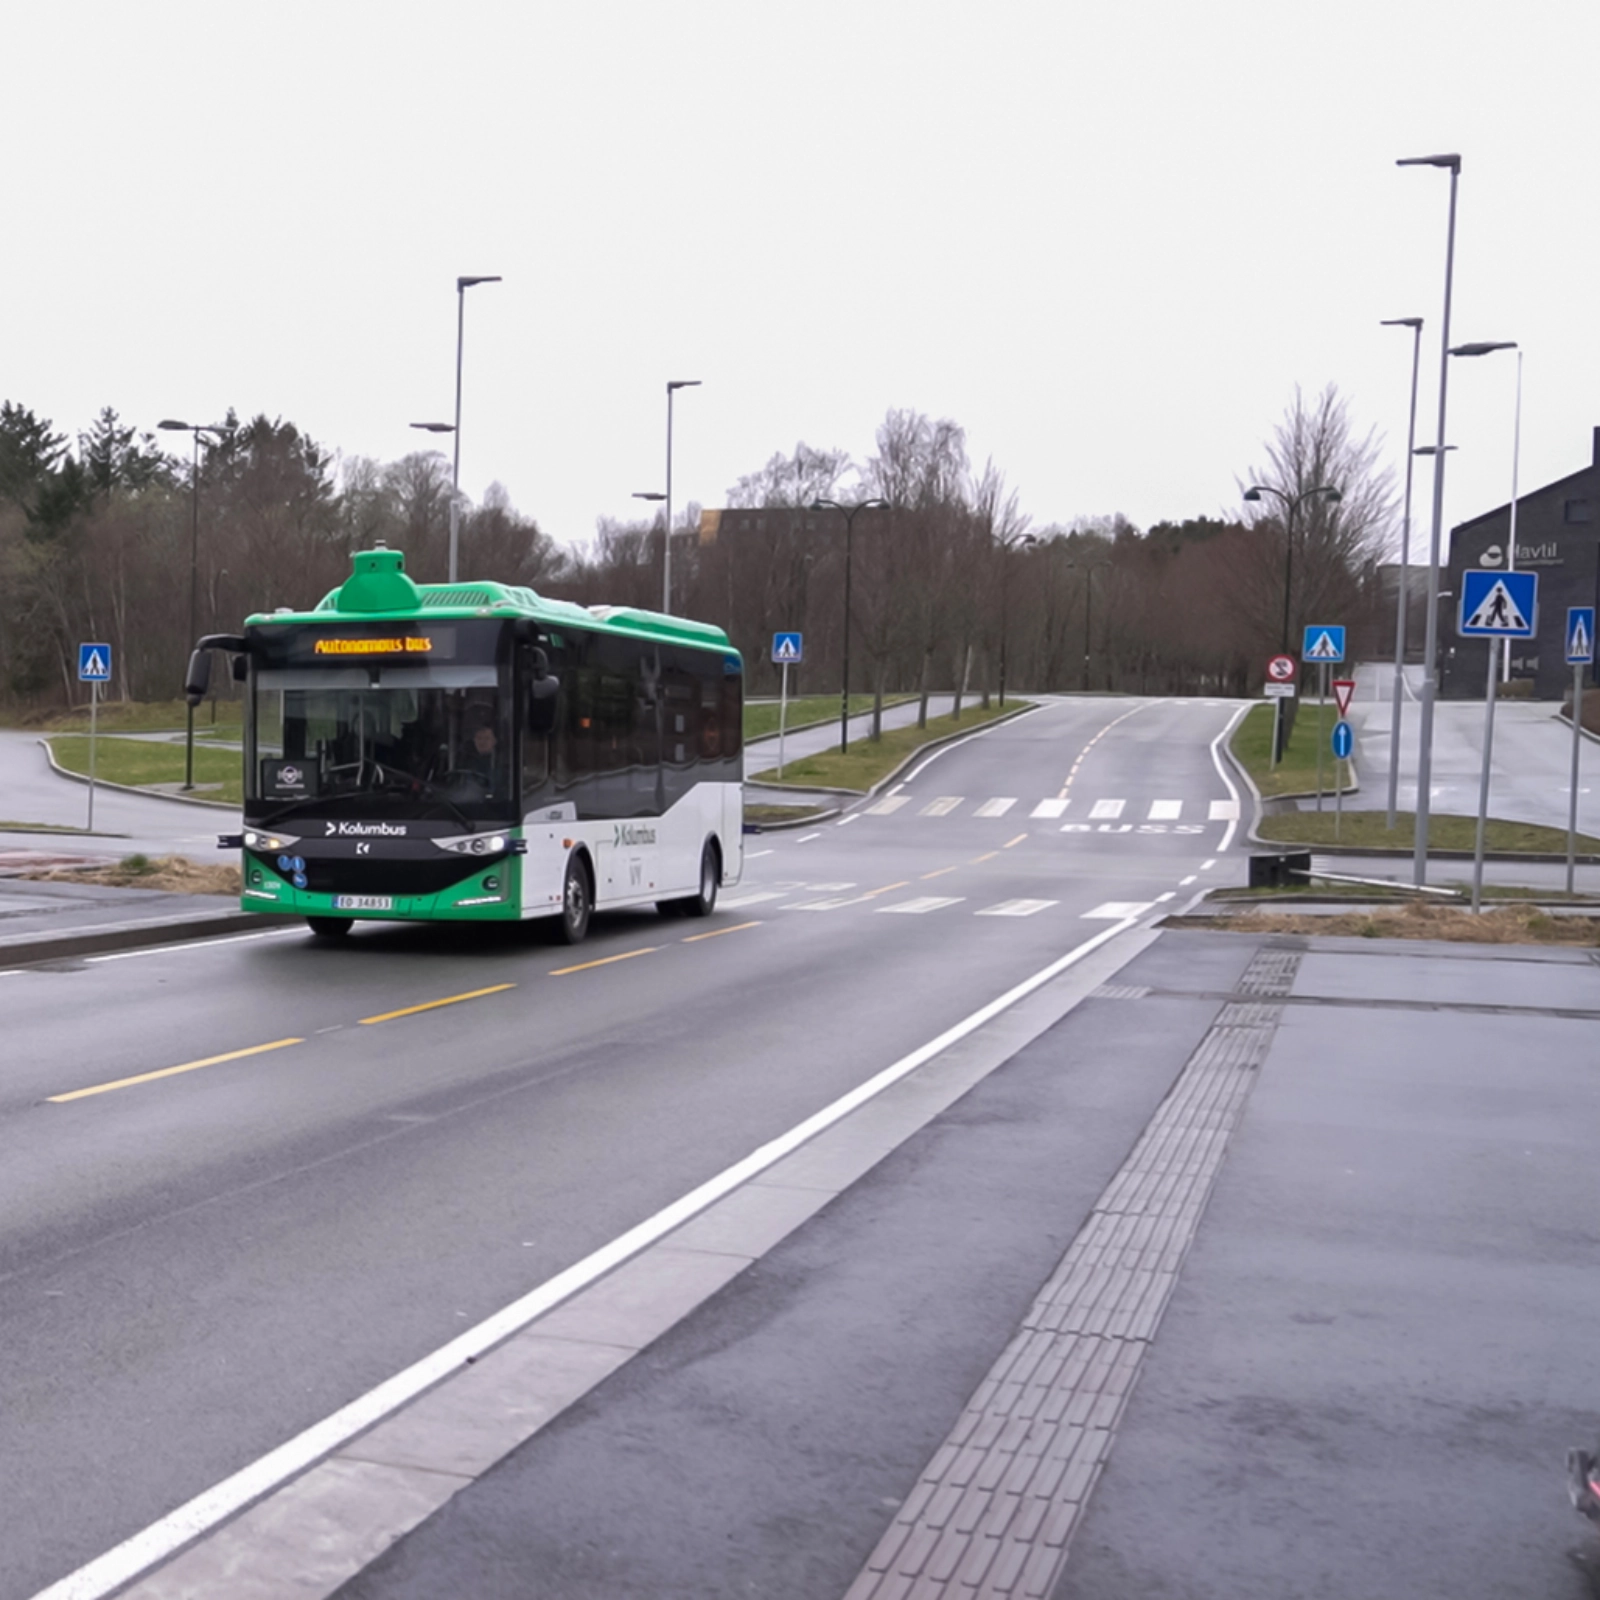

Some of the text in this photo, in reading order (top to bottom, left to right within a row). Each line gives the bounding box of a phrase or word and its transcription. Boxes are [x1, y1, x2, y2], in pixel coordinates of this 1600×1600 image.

[315, 635, 432, 654] Autonomous bus
[338, 821, 406, 836] Kolumbus
[620, 823, 656, 846] Kolumbus
[1059, 824, 1207, 834] BUSS
